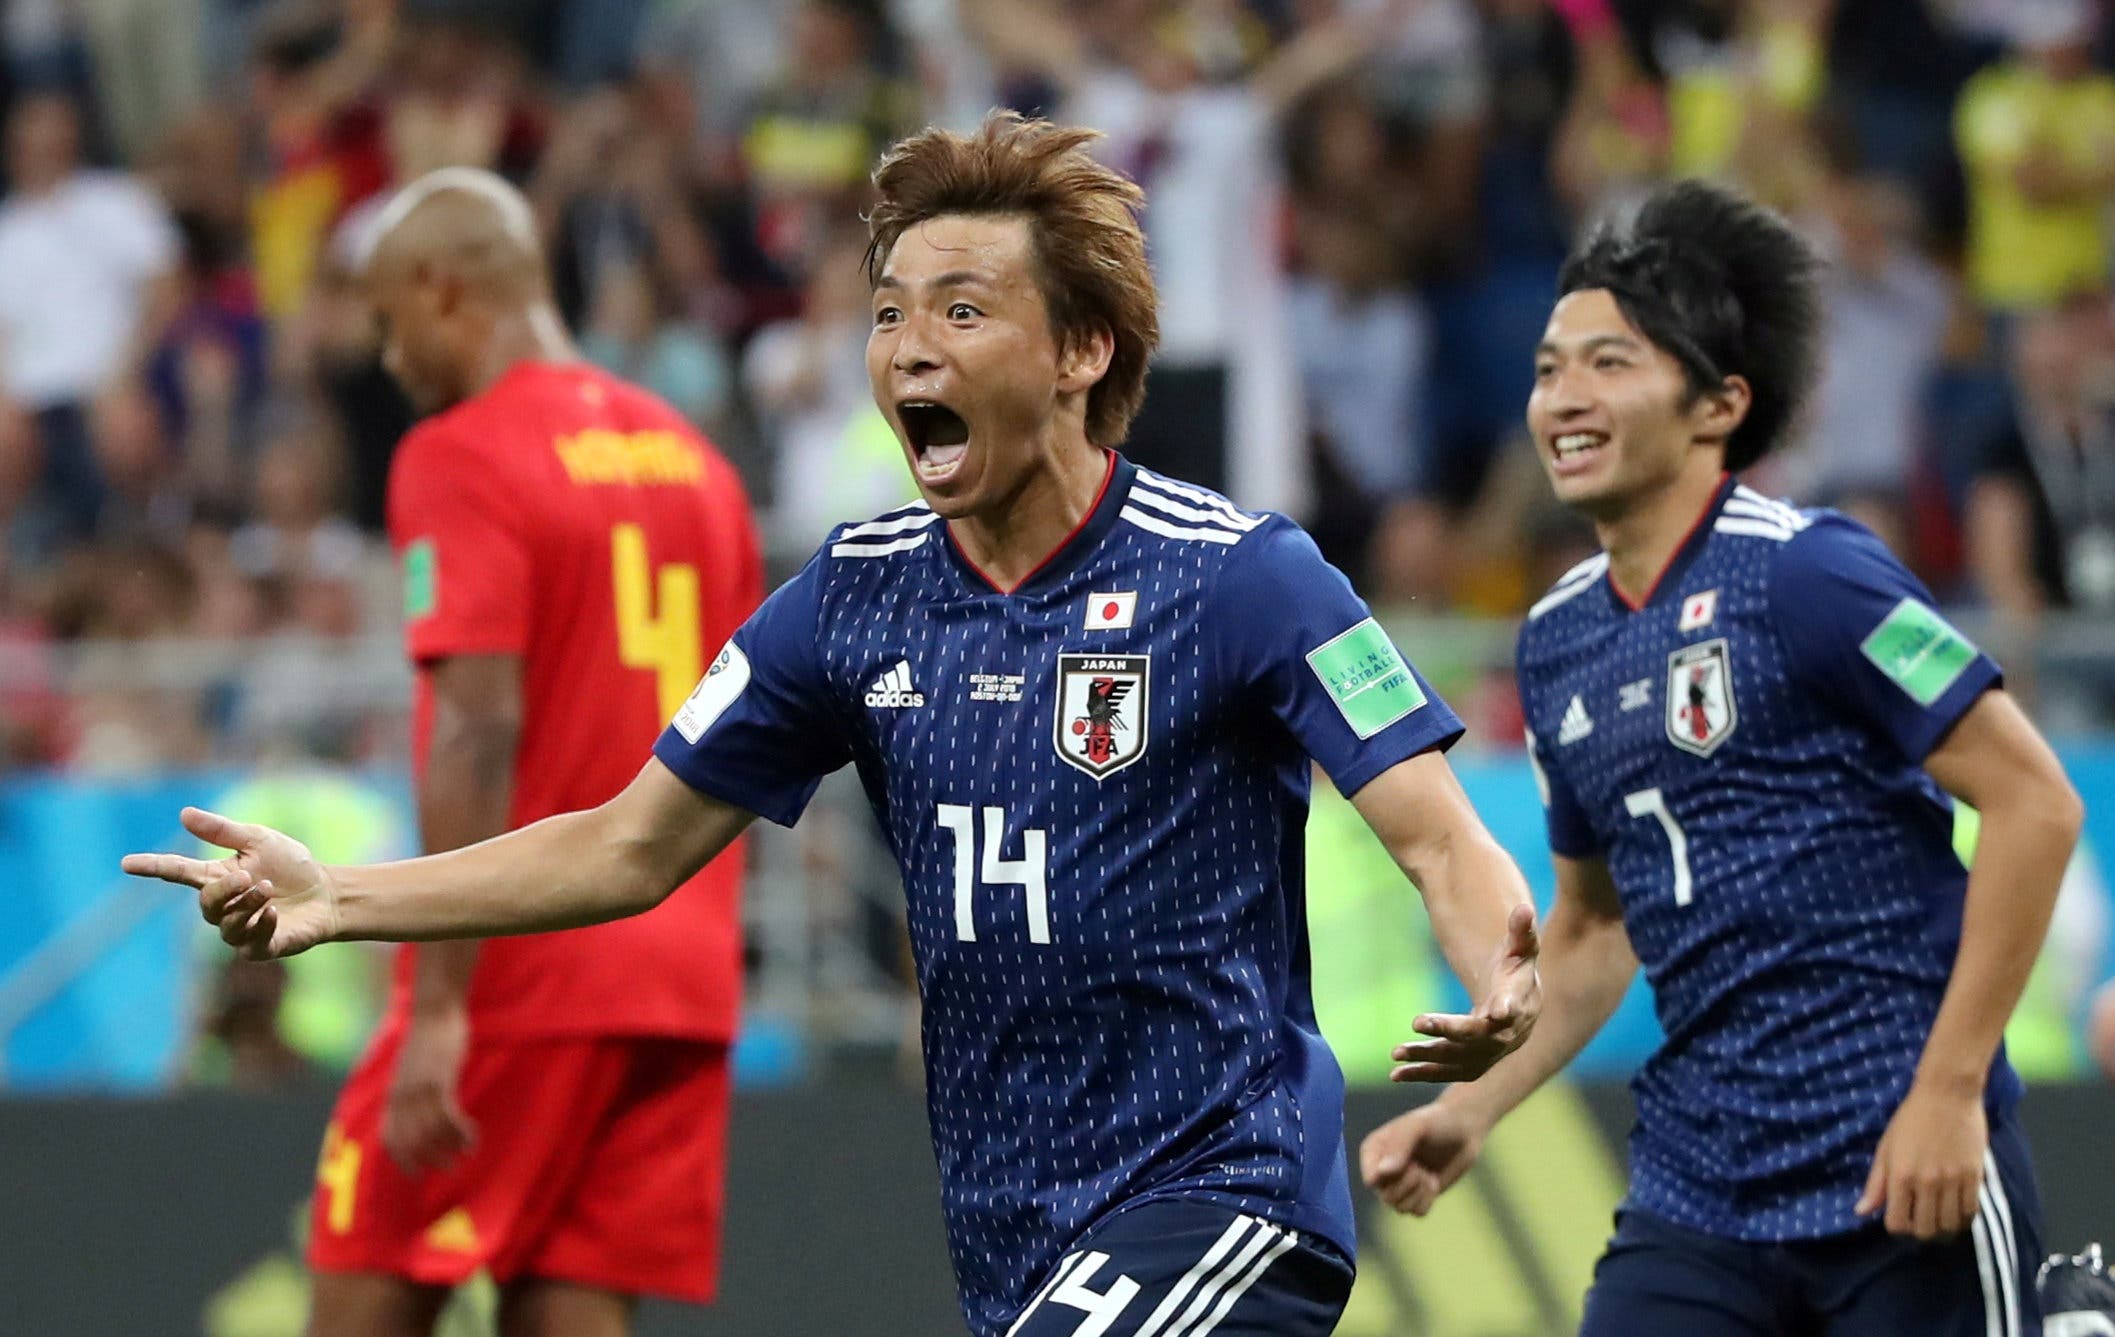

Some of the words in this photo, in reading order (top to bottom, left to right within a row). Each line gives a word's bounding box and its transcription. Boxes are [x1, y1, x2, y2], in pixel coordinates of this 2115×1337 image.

[610, 520, 702, 729] 4
[1081, 660, 1127, 670] JAPAN
[1330, 646, 1390, 686] LIVING
[1382, 672, 1408, 693] FIFA
[865, 690, 924, 708] adidas
[1079, 738, 1118, 755] JFA
[1624, 787, 1693, 907] 7
[937, 804, 1051, 944] 14
[316, 1120, 363, 1235] 4
